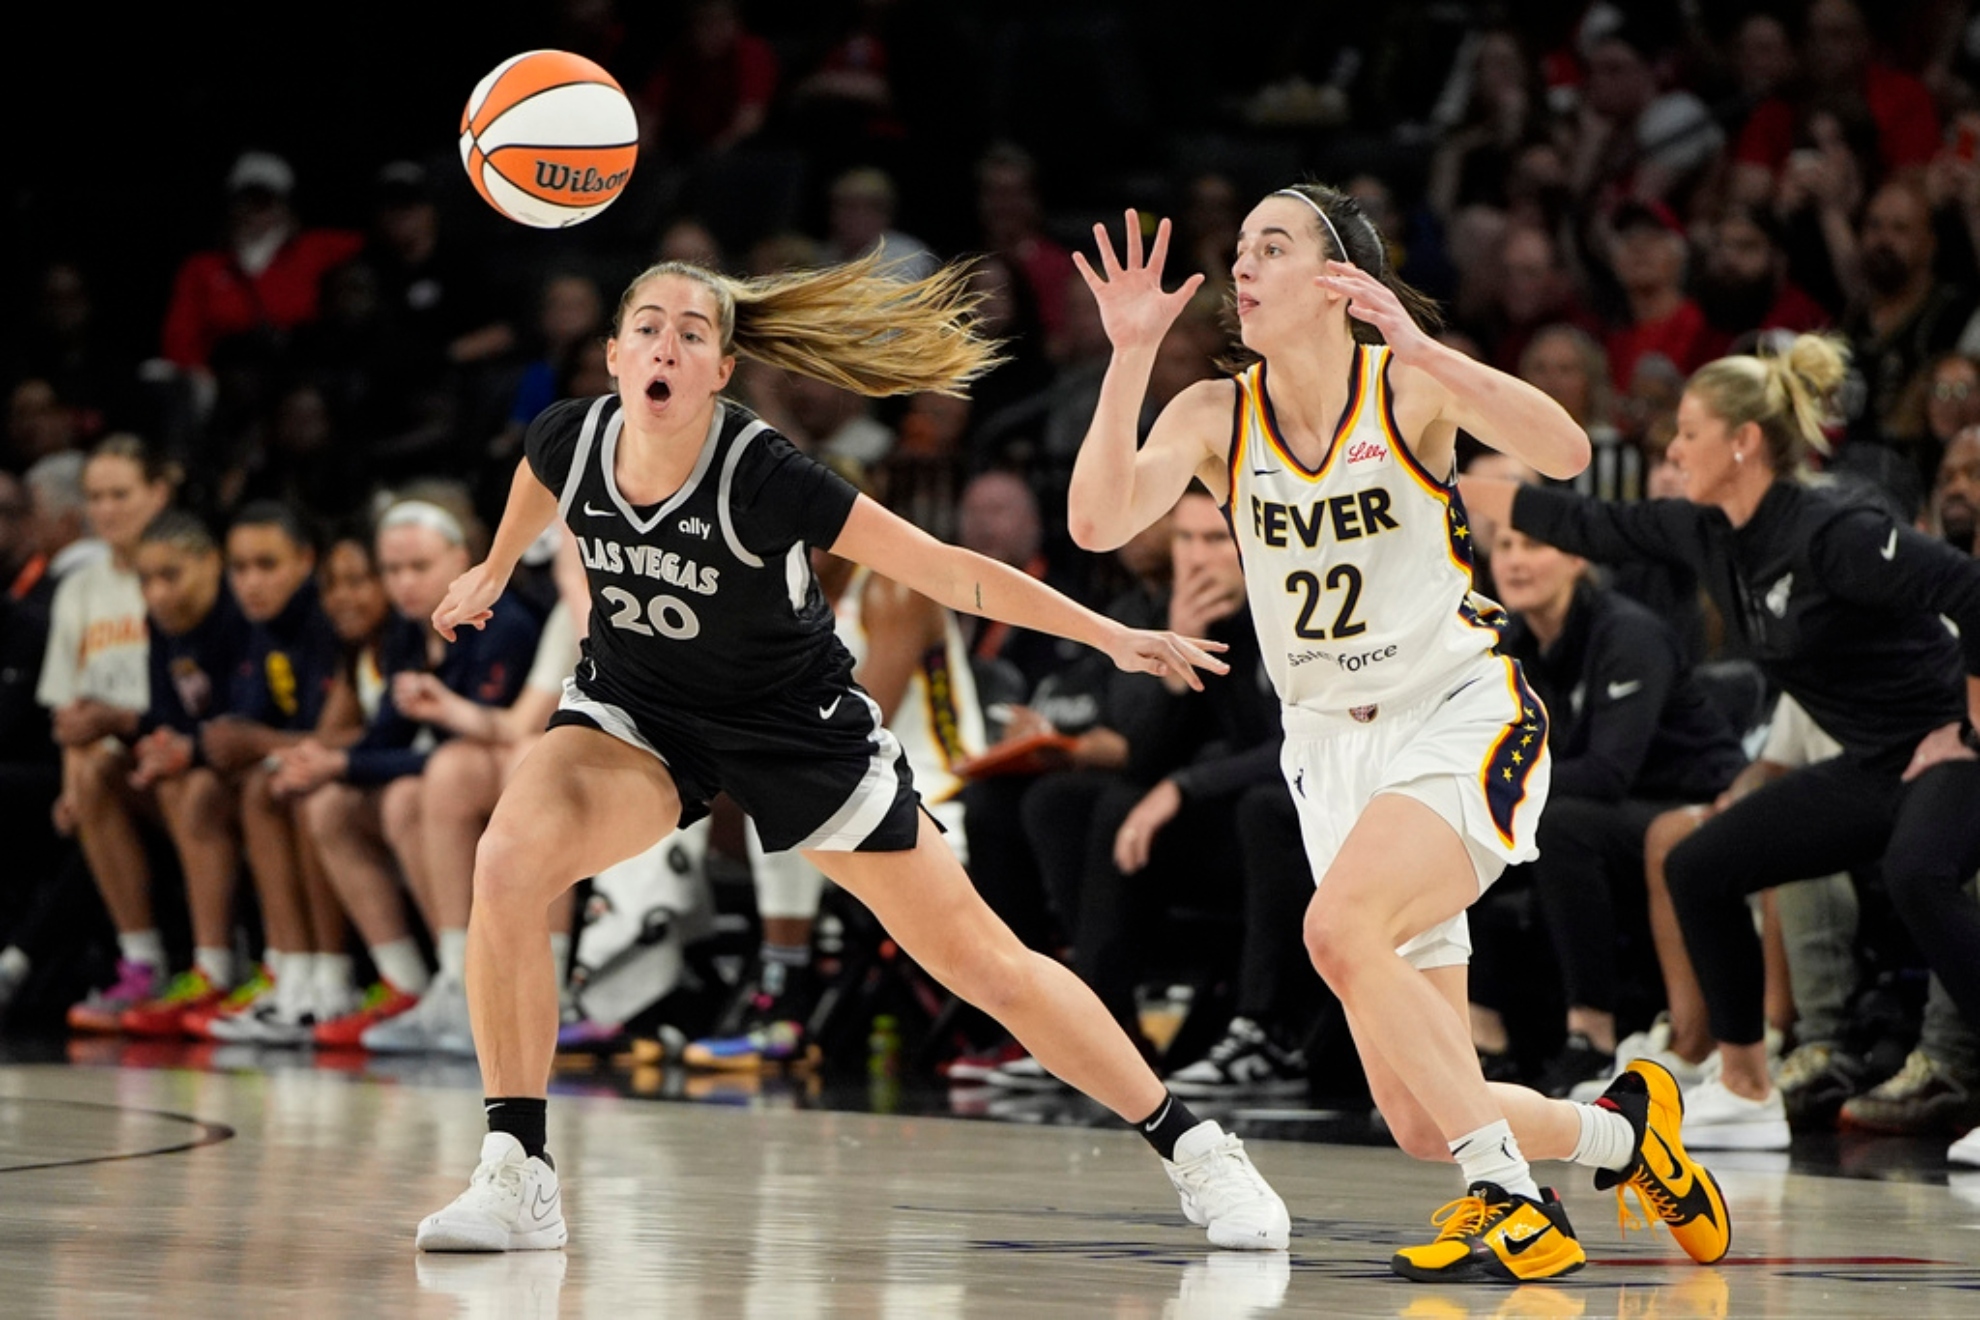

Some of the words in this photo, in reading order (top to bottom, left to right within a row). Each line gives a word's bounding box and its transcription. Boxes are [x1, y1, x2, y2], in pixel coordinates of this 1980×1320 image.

[1347, 441, 1387, 464] Lilly
[678, 516, 711, 540] ally
[1250, 486, 1401, 550] FEVER
[577, 537, 624, 574] LAS
[624, 545, 720, 596] VEGAS
[601, 585, 701, 641] 20
[1285, 563, 1367, 641] 22
